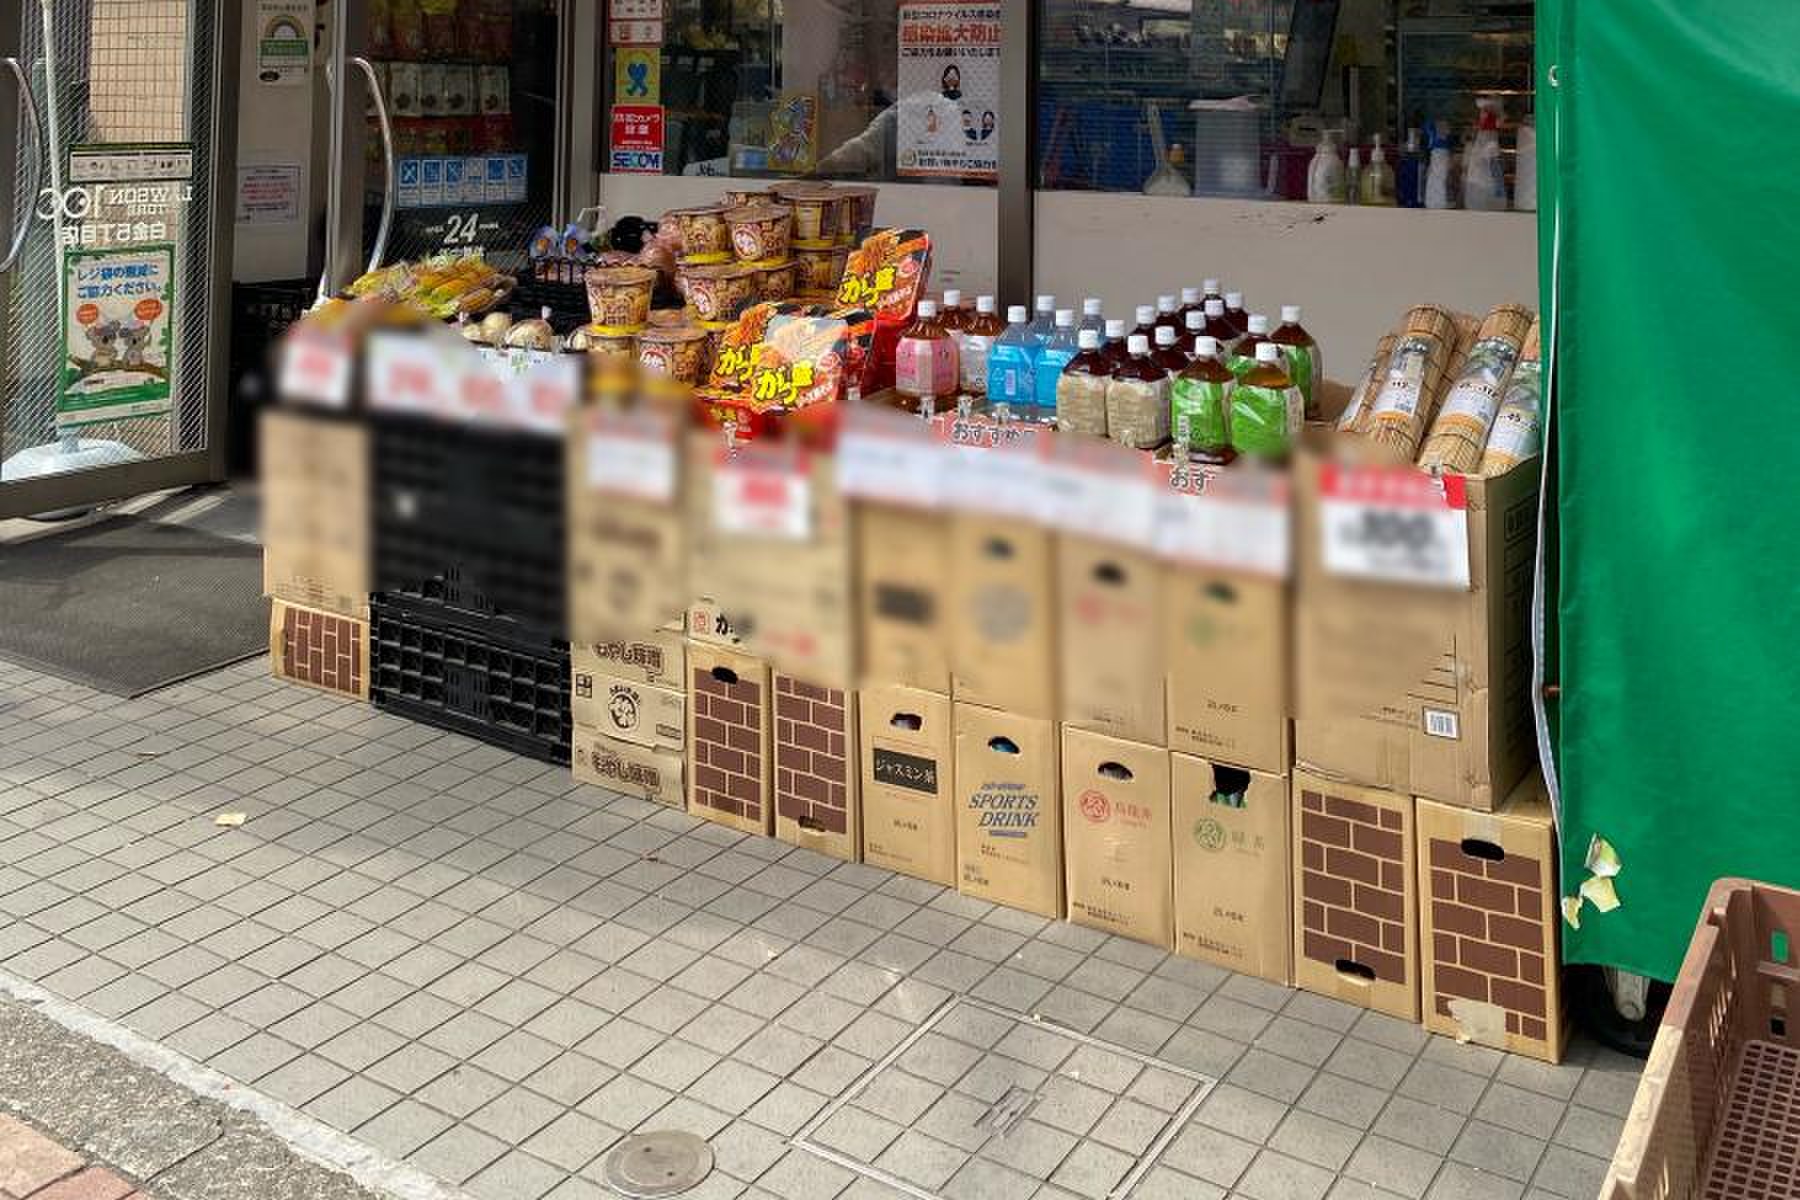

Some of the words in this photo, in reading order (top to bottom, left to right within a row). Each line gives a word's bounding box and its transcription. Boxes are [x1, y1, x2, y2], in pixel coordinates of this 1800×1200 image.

[613, 152, 660, 169] SECOM
[443, 212, 480, 245] 24
[968, 793, 1039, 810] SPORTS
[978, 810, 1040, 828] DRINK
